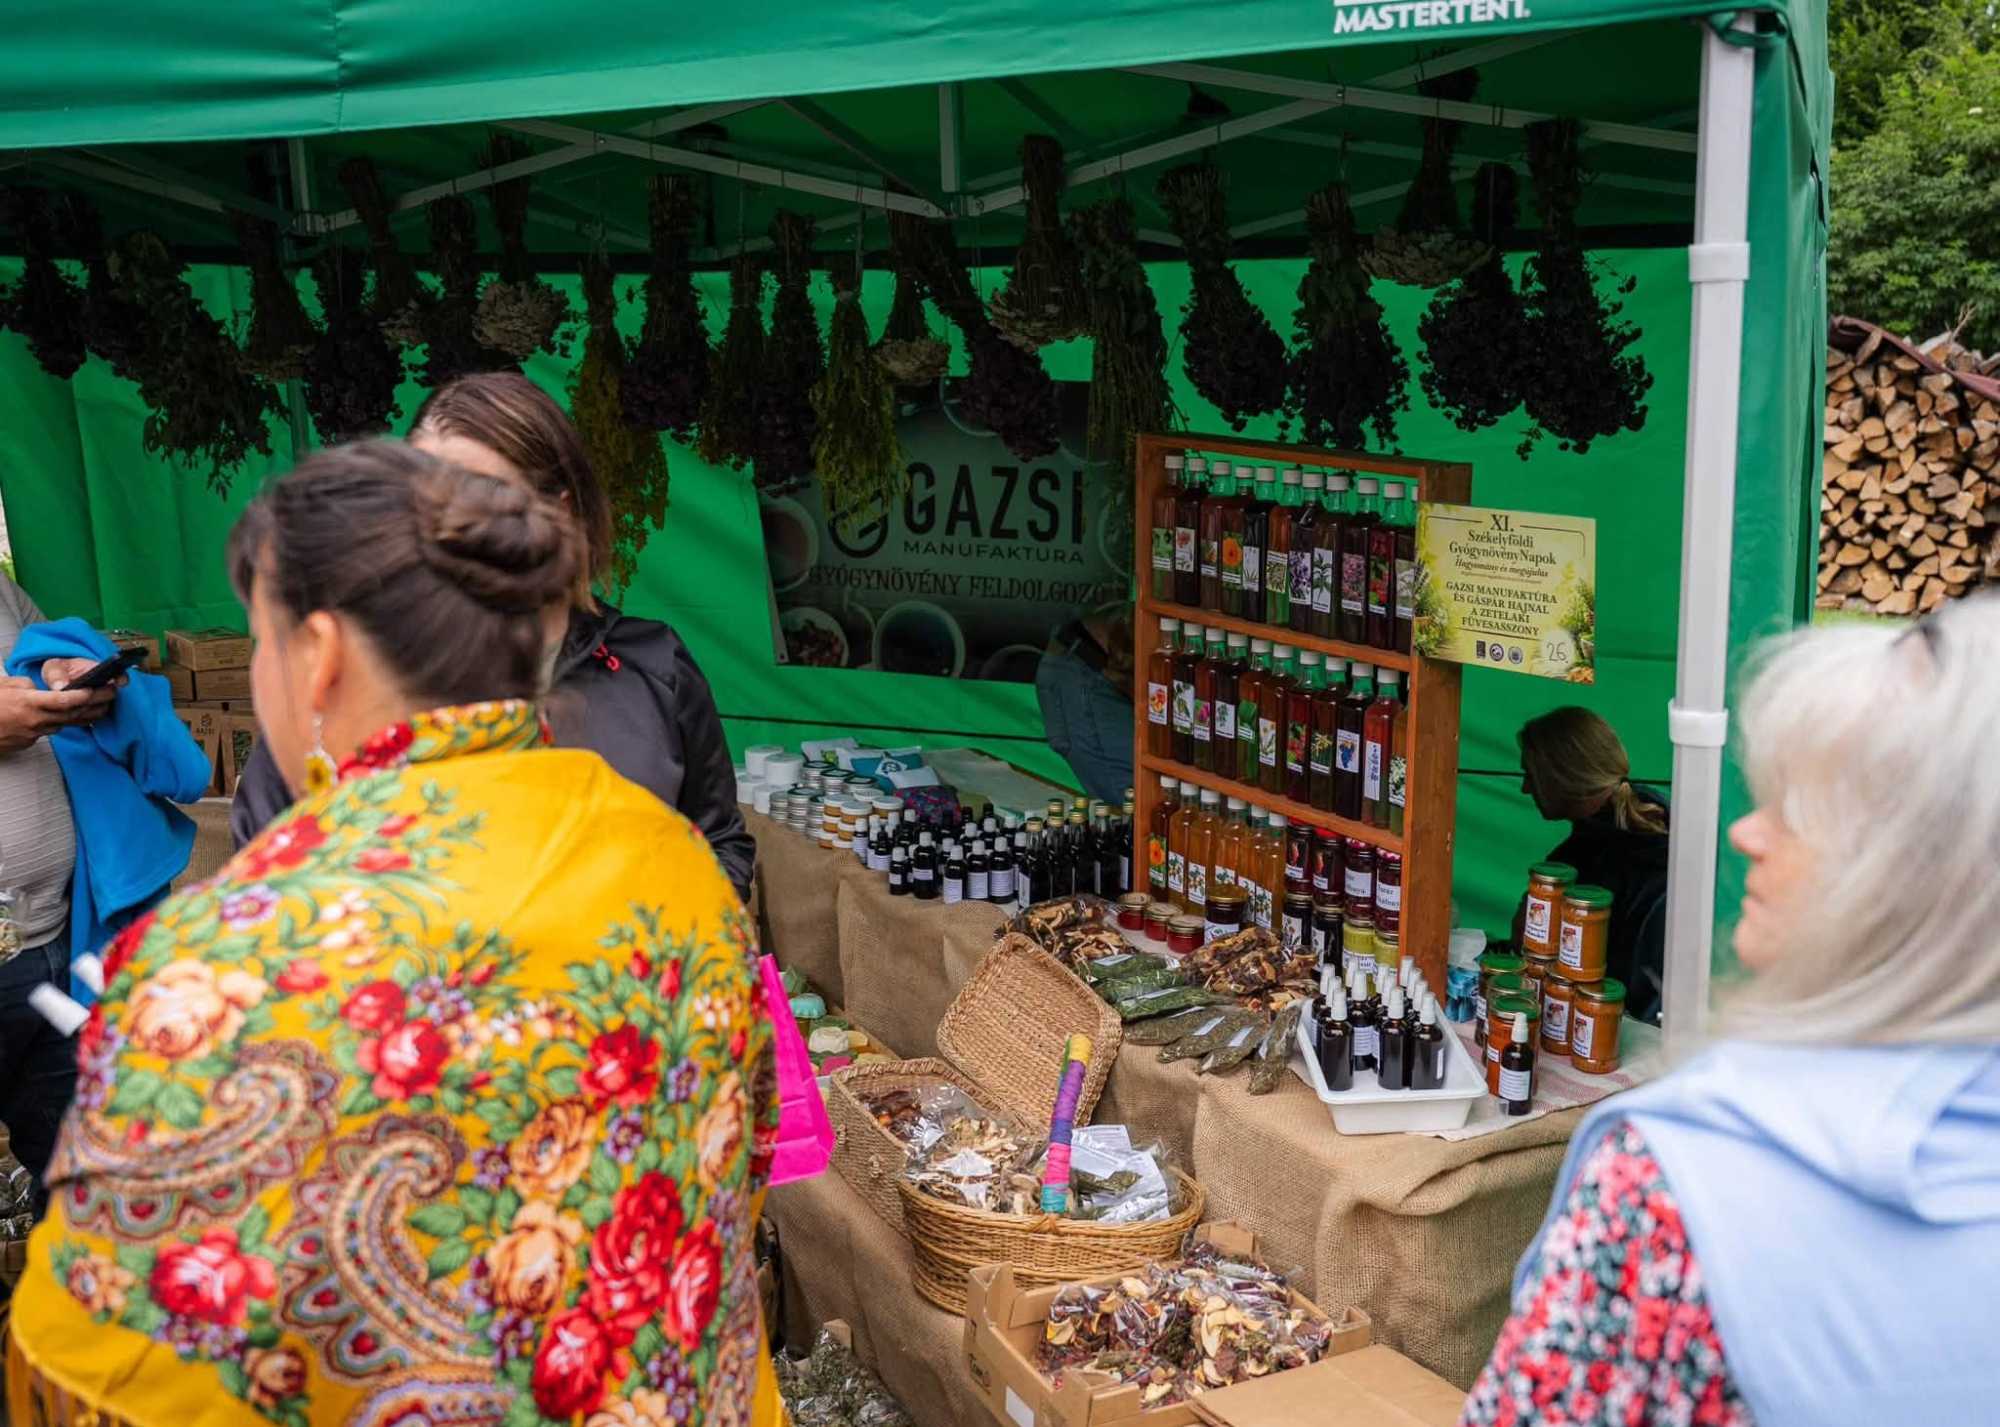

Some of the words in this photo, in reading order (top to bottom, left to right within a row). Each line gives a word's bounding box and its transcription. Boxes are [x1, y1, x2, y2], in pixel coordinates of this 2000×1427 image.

[903, 461, 1084, 545] GAZSI
[1490, 514, 1514, 532] XI.
[1468, 529, 1534, 548] Székelyföldi
[1446, 581, 1474, 593] GAZSI
[1471, 607, 1478, 616] A
[1480, 608, 1531, 623] ZETELAKI
[1508, 600, 1550, 615] HAJNAL
